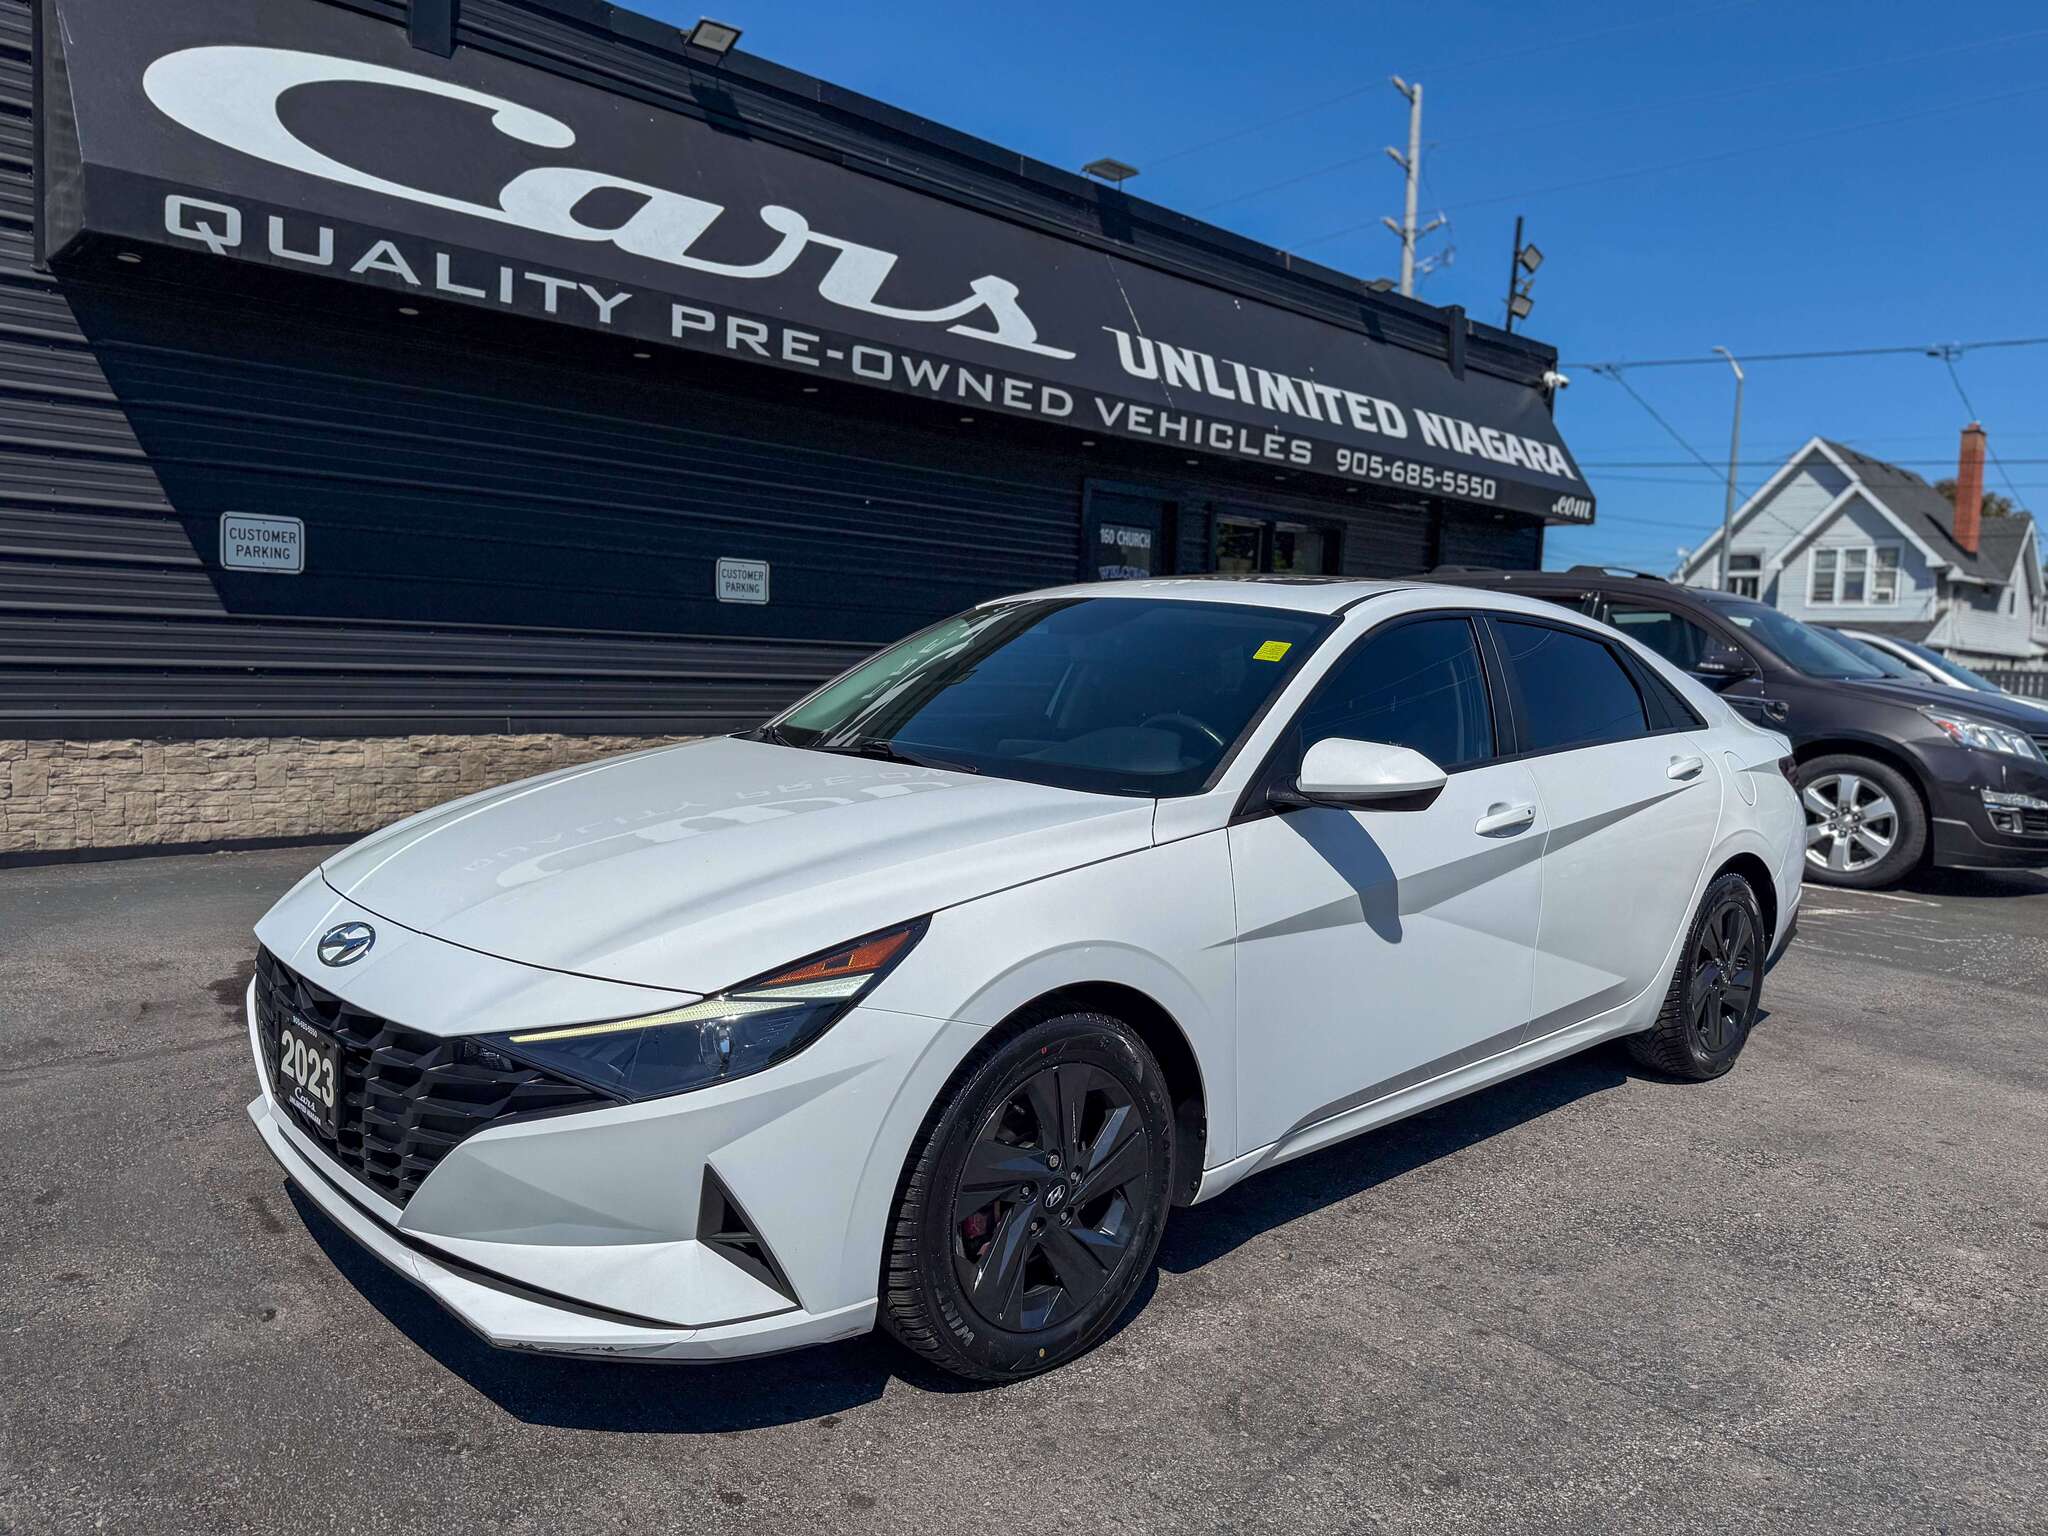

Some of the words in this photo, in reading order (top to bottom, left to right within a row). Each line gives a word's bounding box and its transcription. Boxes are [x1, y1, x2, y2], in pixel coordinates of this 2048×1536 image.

[143, 46, 1076, 359] Cars
[165, 195, 632, 324] QUALITY
[672, 304, 1073, 417] PRE-OWNED
[1094, 397, 1312, 465] VEHICLES
[1336, 449, 1496, 499] 905-685-5550
[1101, 326, 1408, 439] UNLIMITED
[1413, 408, 1578, 481] NIAGARA
[1551, 496, 1592, 519] .com
[229, 527, 297, 544] CUSTOMER
[1116, 530, 1152, 549] CHURCH
[236, 544, 290, 560] PARKING
[721, 568, 764, 581] CUSTOMER
[725, 582, 760, 593] PARKING
[280, 1029, 334, 1108] 2023
[294, 1086, 317, 1113] Cars
